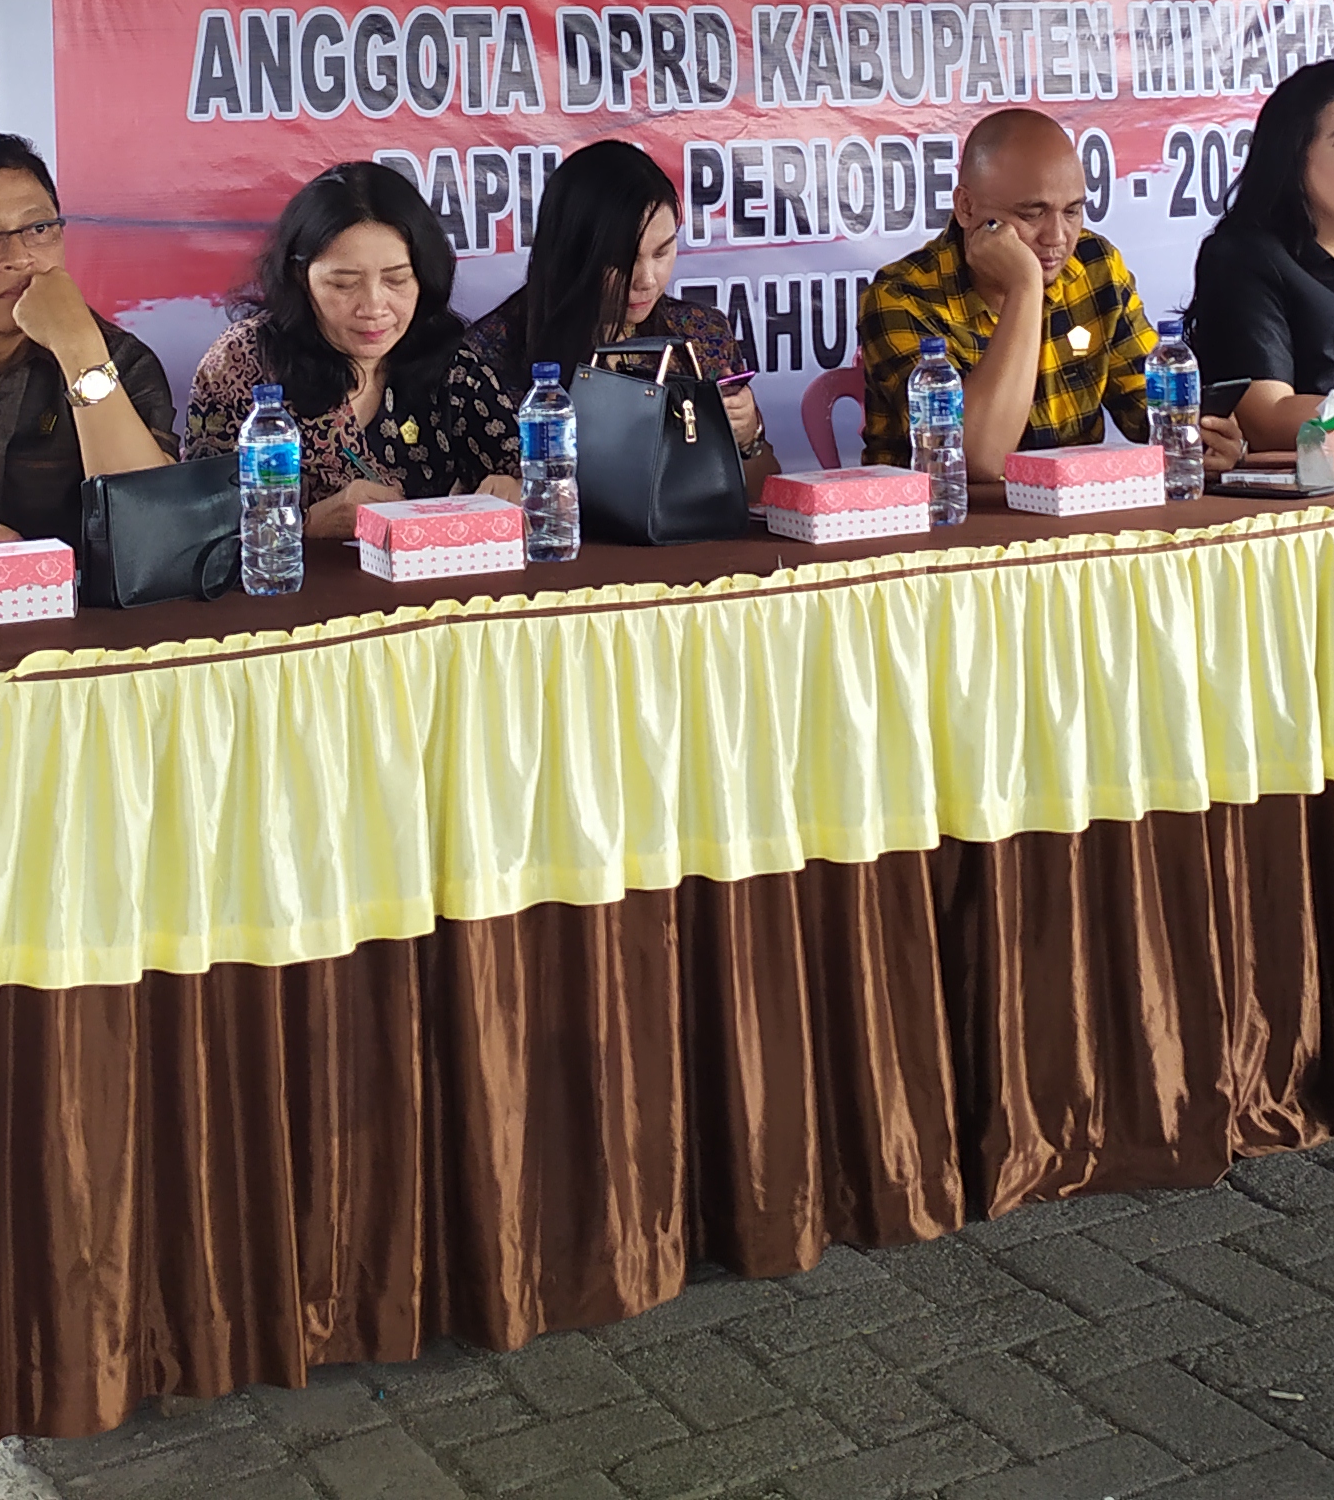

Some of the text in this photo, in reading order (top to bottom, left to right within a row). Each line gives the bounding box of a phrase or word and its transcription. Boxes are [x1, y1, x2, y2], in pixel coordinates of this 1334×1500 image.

[190, 7, 543, 120] ANGGOTA
[558, 7, 735, 111] DPRD
[757, 4, 1115, 110] KABUPATEN
[375, 147, 562, 256] API
[686, 136, 958, 246] PERIODE
